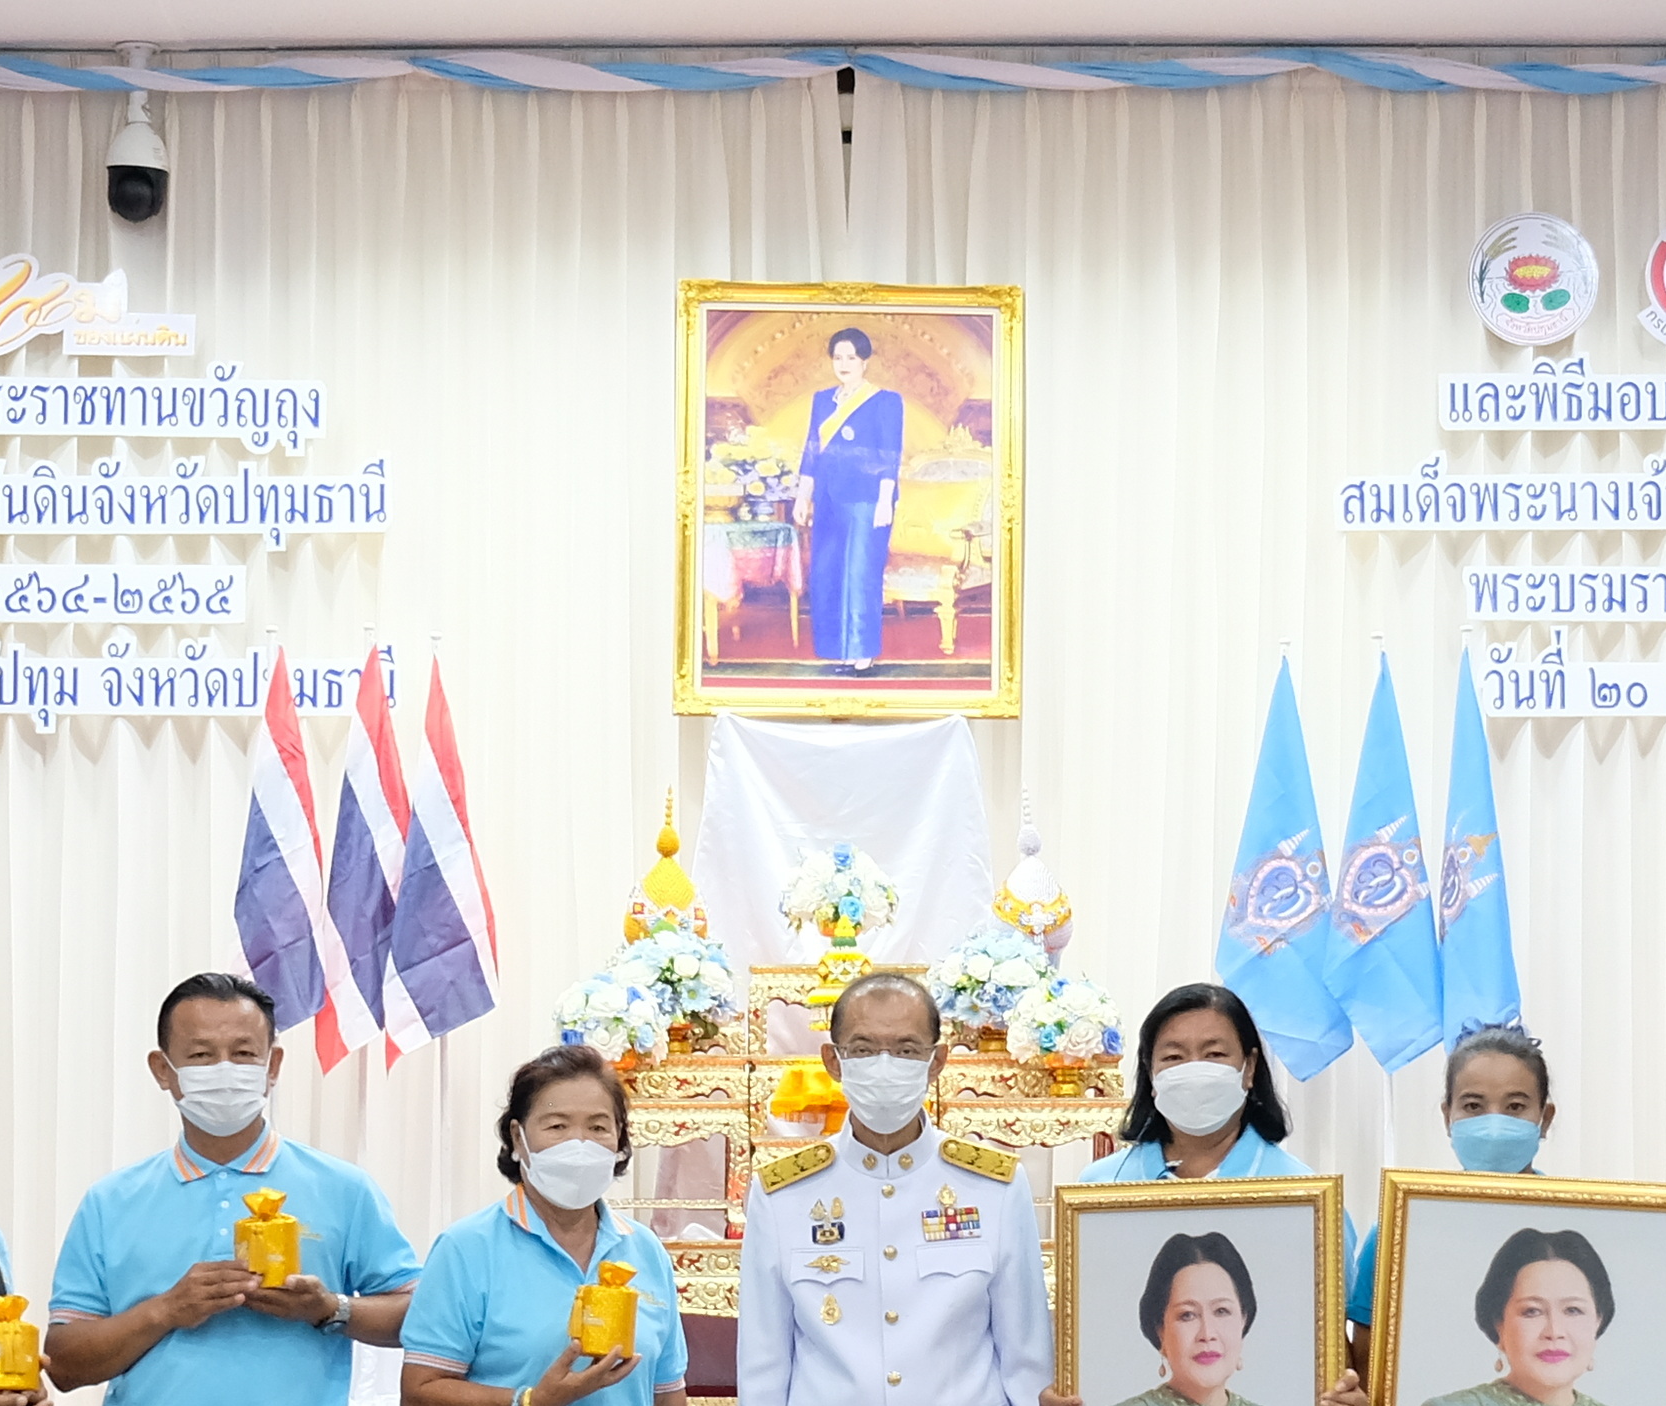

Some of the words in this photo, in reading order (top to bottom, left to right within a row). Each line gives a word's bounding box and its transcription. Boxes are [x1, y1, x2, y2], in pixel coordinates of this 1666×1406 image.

[1484, 629, 1567, 711] วันที่
[1587, 668, 1649, 710] ๒๐
